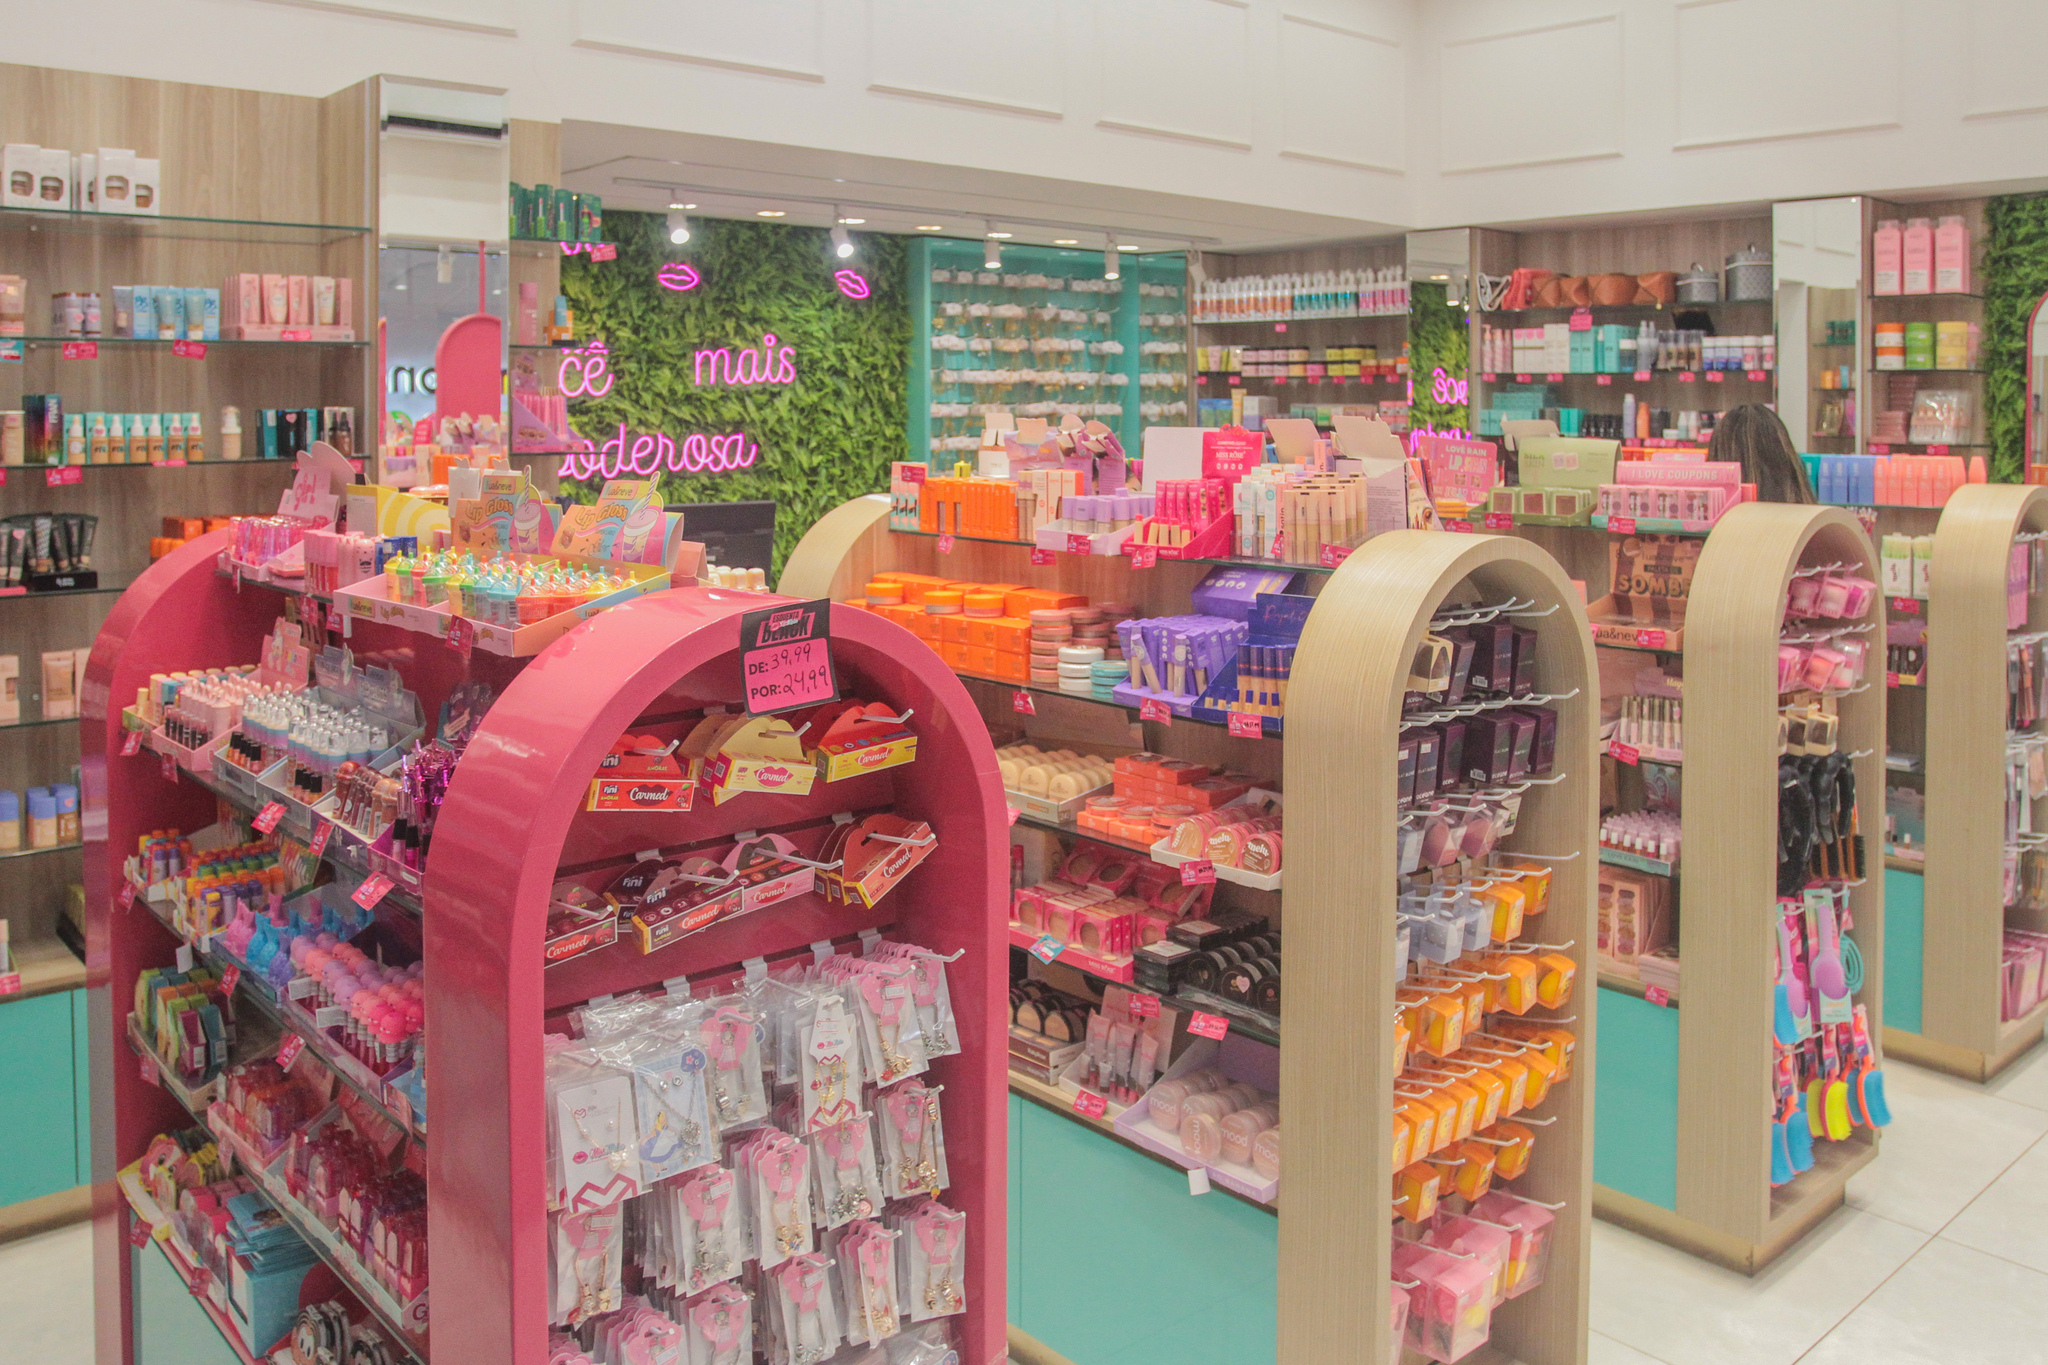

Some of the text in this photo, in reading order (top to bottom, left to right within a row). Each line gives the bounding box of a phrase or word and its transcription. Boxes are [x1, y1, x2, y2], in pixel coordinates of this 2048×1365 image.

[693, 332, 797, 387] mais
[1216, 451, 1229, 459] MISS
[1466, 447, 1487, 456] RAIN
[1638, 470, 1665, 480] LOVE
[1667, 470, 1718, 481] COUPONS
[1596, 627, 1638, 641] ua&nev
[749, 643, 812, 675] DE: 39,99
[751, 665, 829, 700] POR: 24,99
[602, 753, 620, 768] ini
[857, 747, 891, 766] Carmed
[755, 768, 791, 783] Carmed
[629, 786, 669, 802] Carmed
[1208, 832, 1232, 846] melu
[1247, 841, 1270, 857] melu
[883, 847, 912, 878] Carmed
[753, 883, 788, 903] Carmed
[681, 905, 720, 930] Carmed
[546, 935, 590, 959] Carmed
[1149, 1096, 1177, 1115] mood
[1220, 1128, 1249, 1147] mood
[1254, 1143, 1279, 1164] moo
